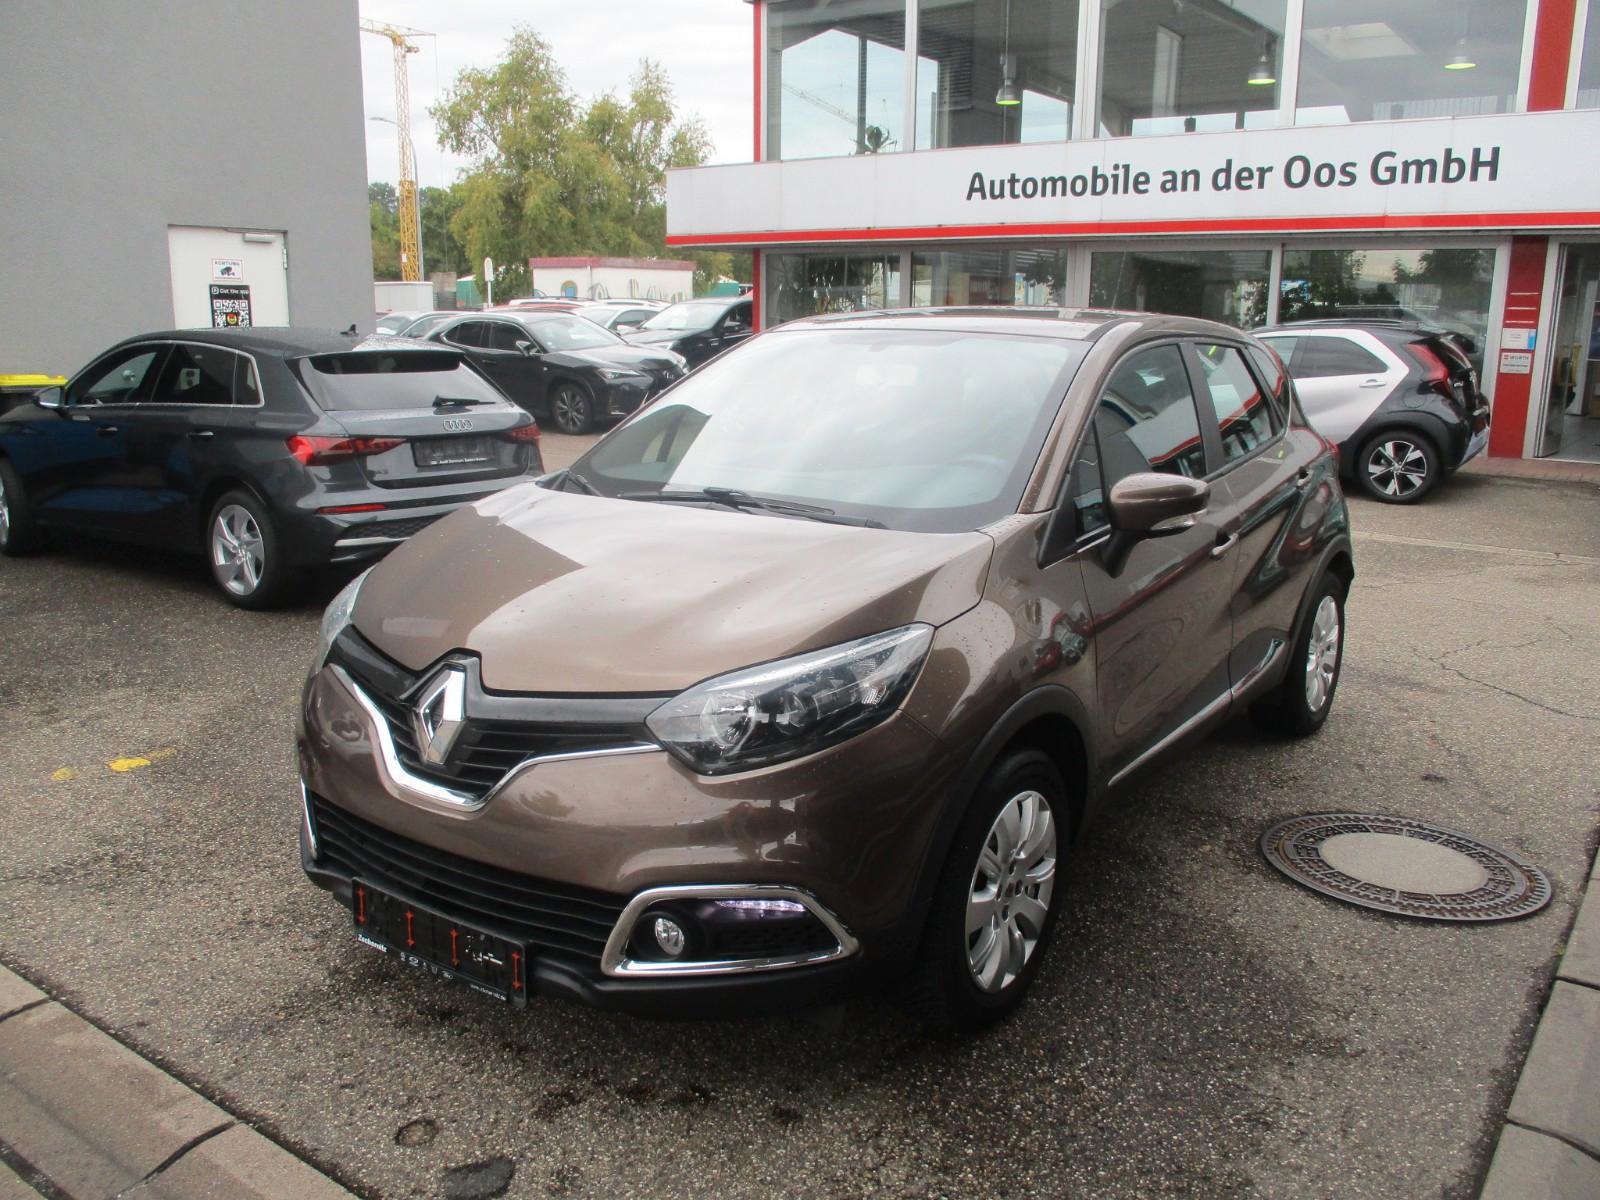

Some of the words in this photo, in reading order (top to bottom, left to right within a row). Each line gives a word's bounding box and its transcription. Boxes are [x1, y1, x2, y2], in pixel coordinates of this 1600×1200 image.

[967, 164, 1150, 200] Automobile
[1160, 169, 1200, 193] an
[1212, 159, 1273, 191] der
[1284, 156, 1357, 188] Oos
[1371, 147, 1500, 185] GmbH
